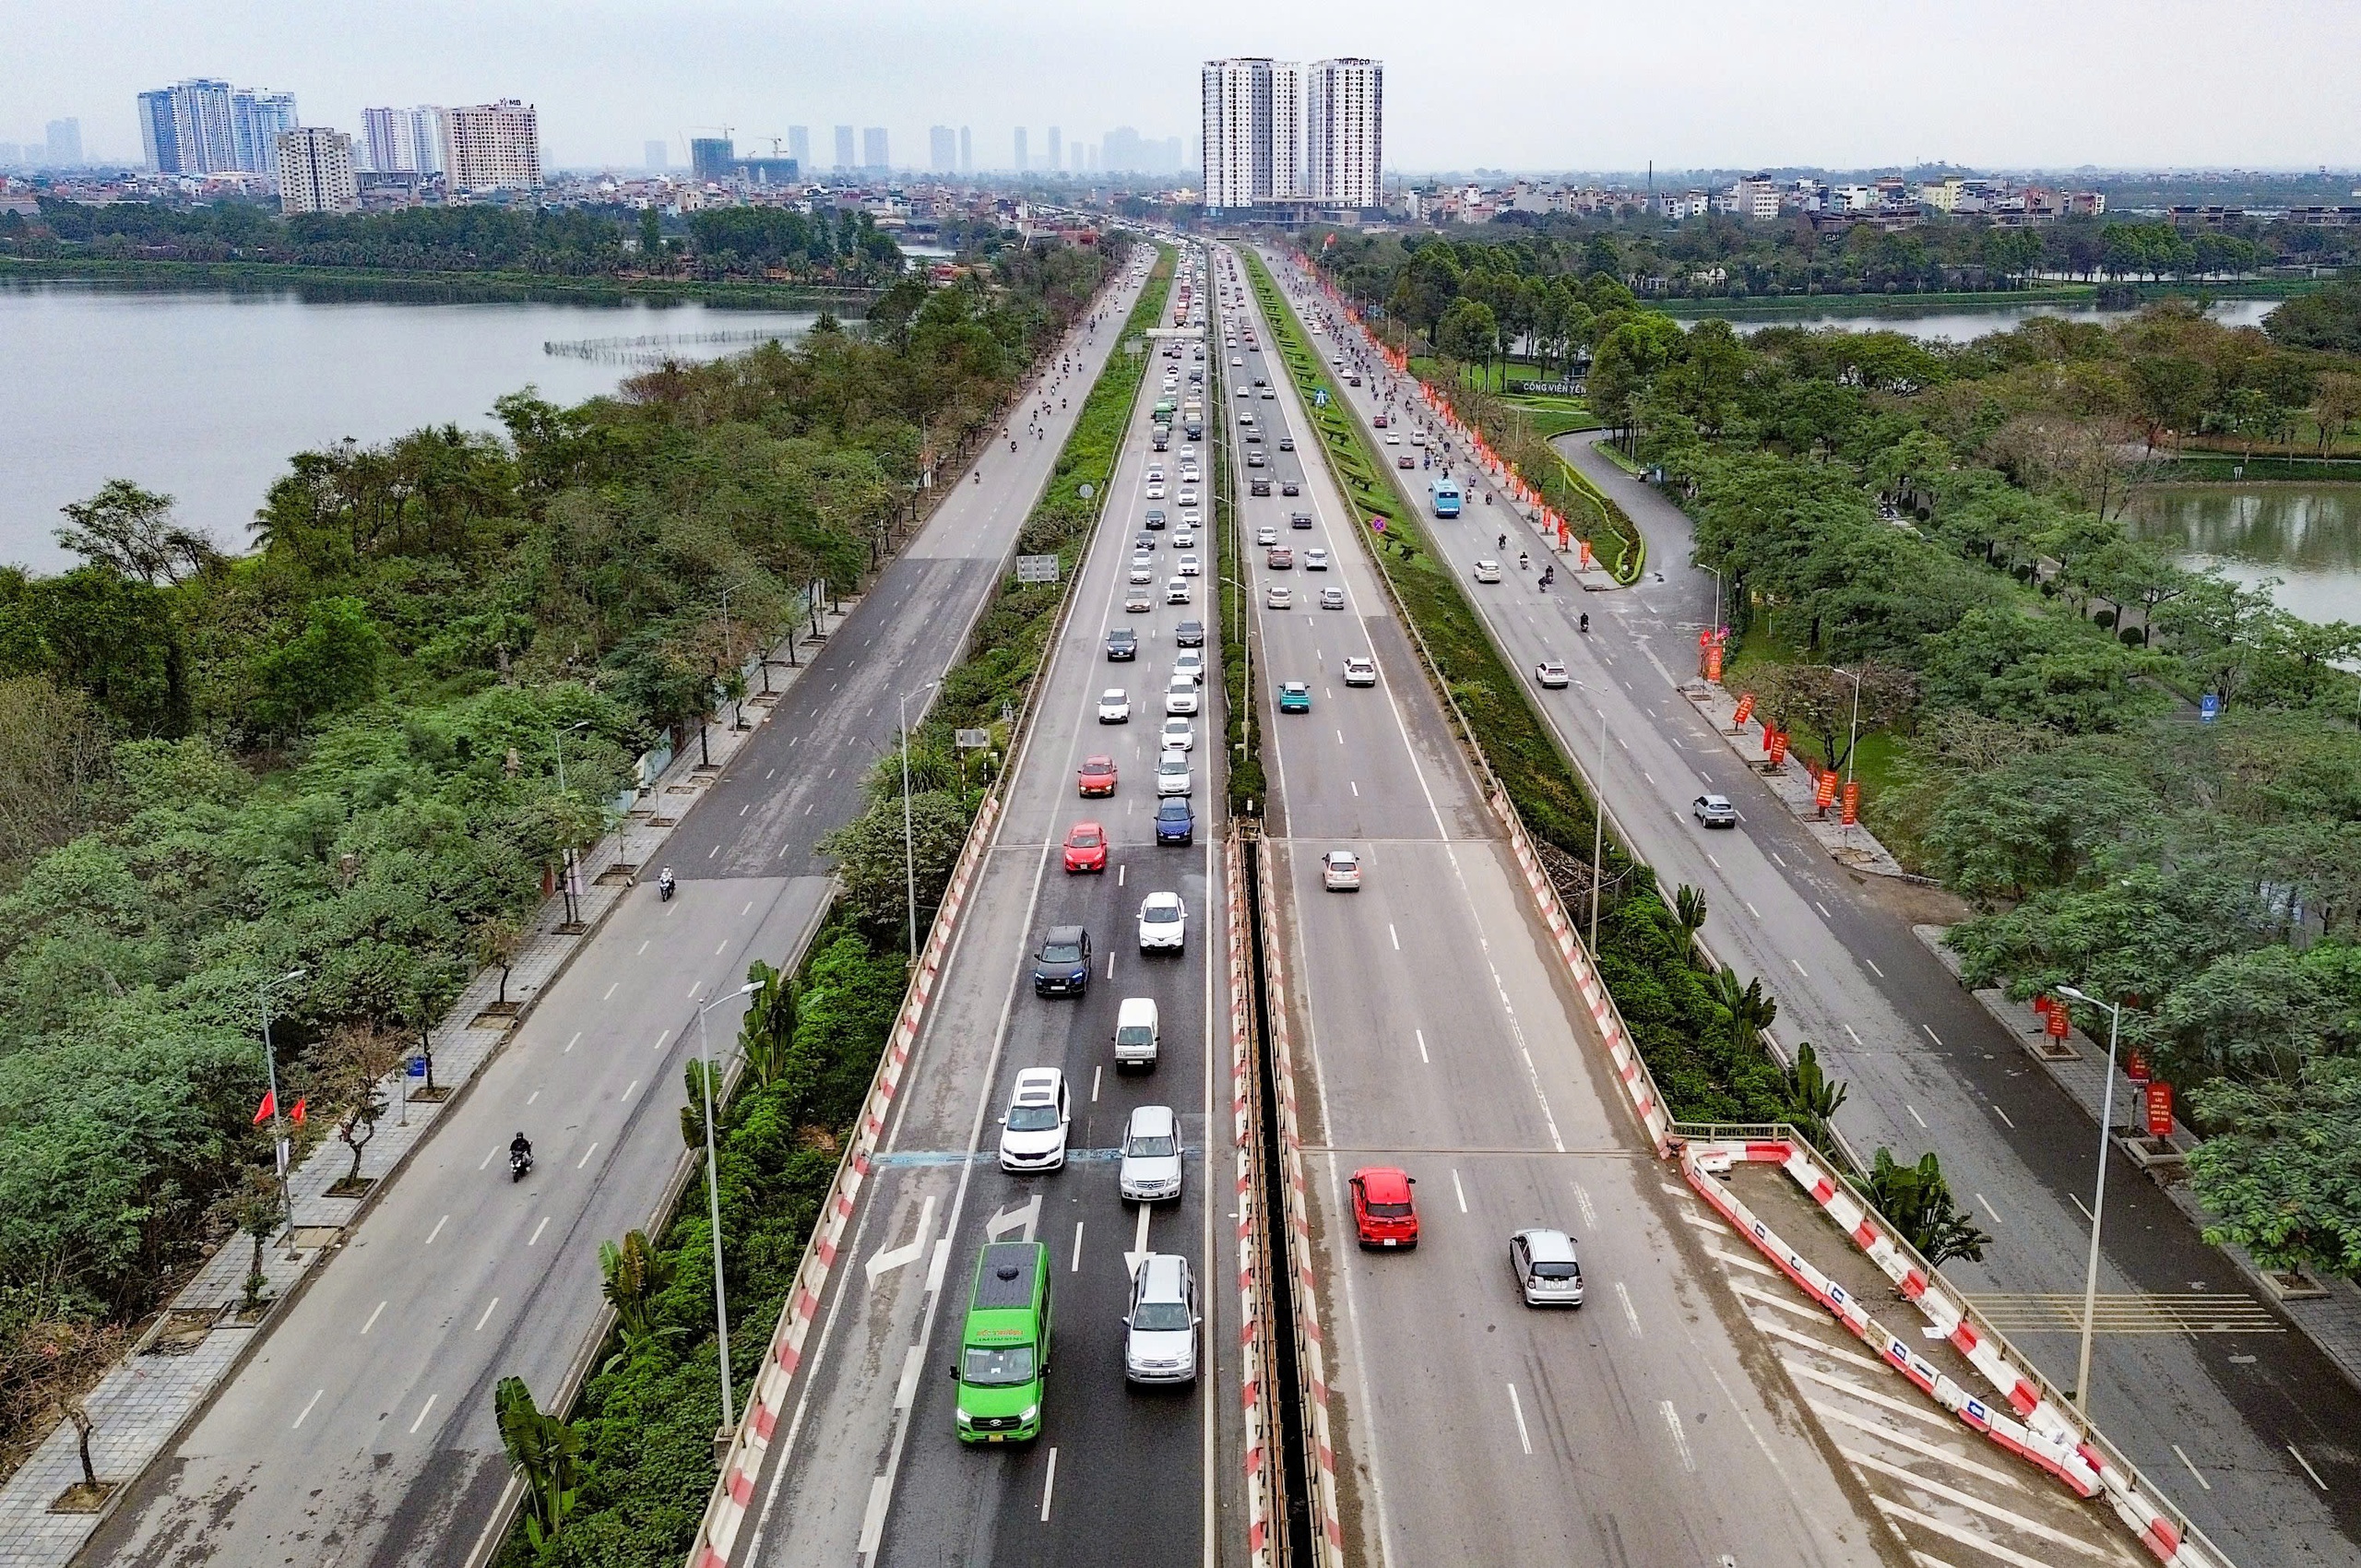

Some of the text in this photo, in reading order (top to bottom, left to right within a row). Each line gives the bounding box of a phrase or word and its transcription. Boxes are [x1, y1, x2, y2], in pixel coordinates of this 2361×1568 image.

[1524, 382, 1587, 394] CÔNG VIÊN YÊN
